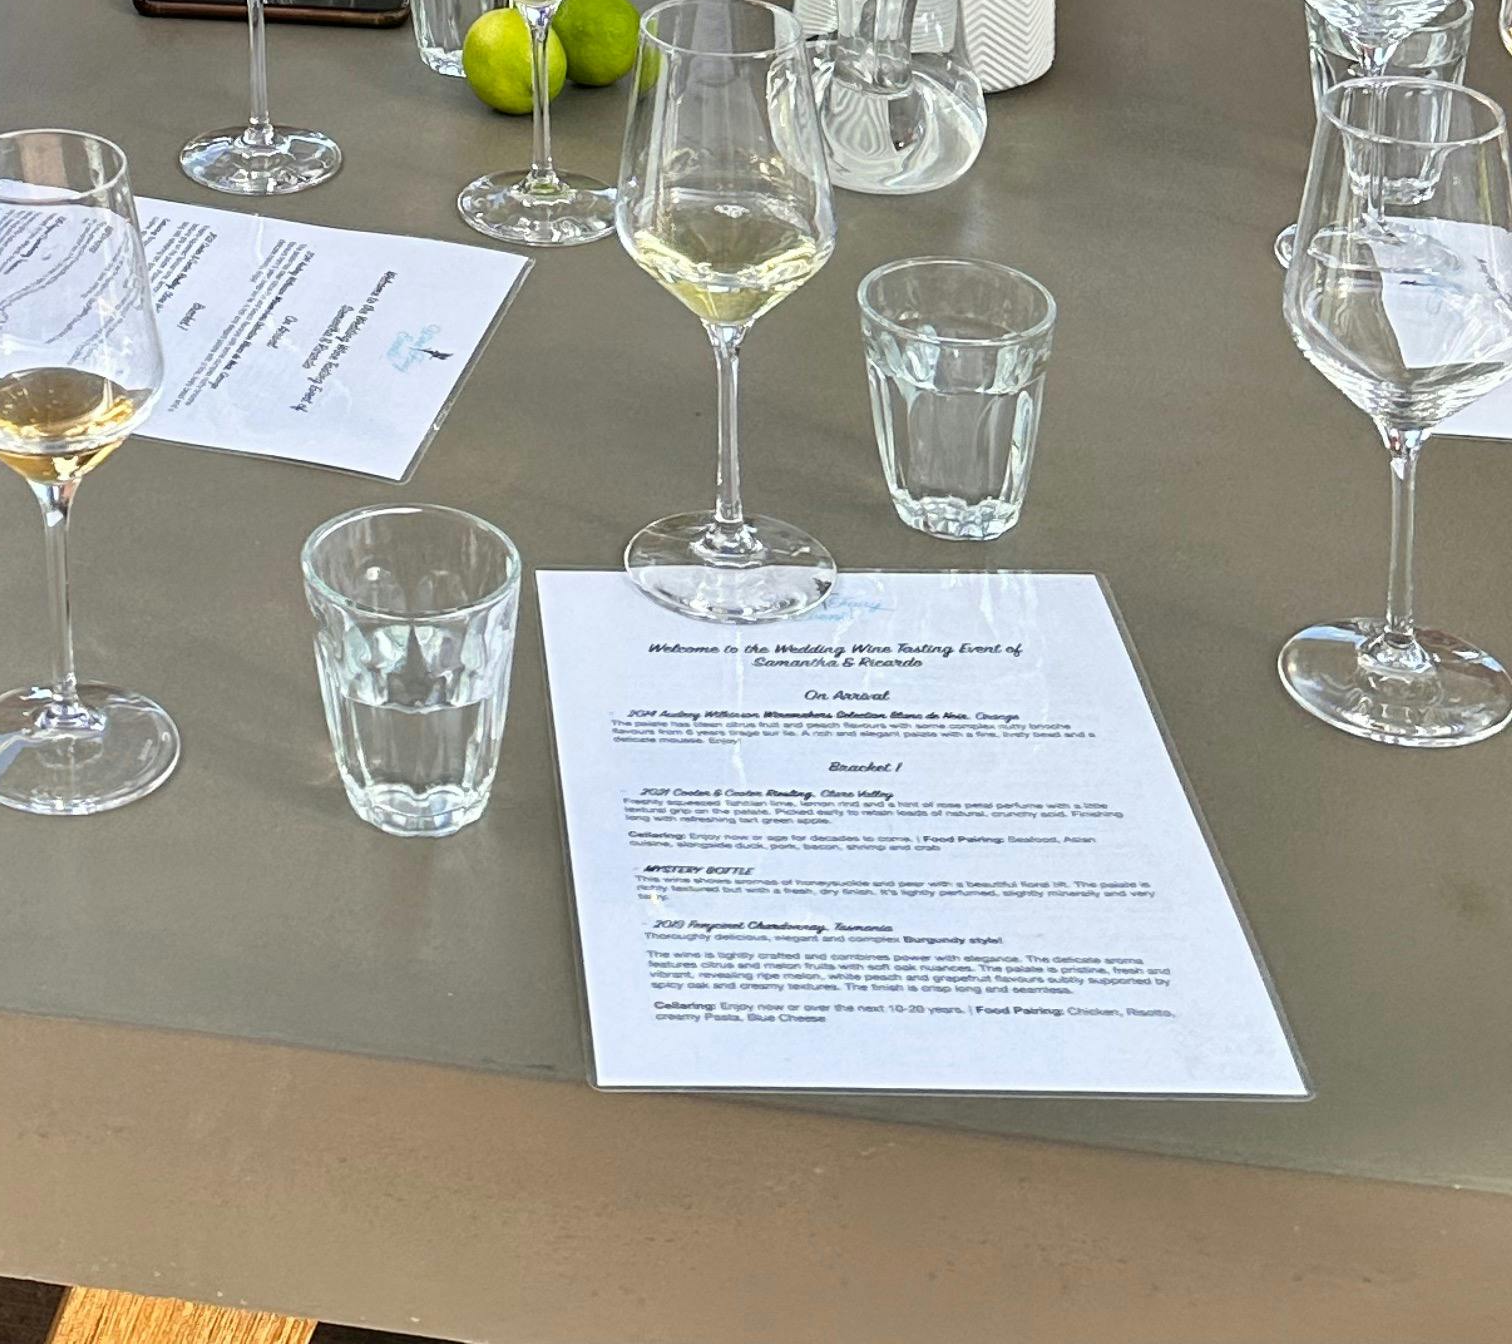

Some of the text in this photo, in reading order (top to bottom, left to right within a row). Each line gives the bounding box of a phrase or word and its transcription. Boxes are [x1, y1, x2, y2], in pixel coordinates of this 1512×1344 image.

[647, 642, 1025, 656] Welcome to the Wedding Wine Tasting Event of
[751, 656, 838, 666] Samantha
[857, 656, 924, 666] Ricardo
[802, 689, 890, 700] On Arrival
[827, 761, 891, 771] Bracket
[643, 865, 703, 873] MYSTERY
